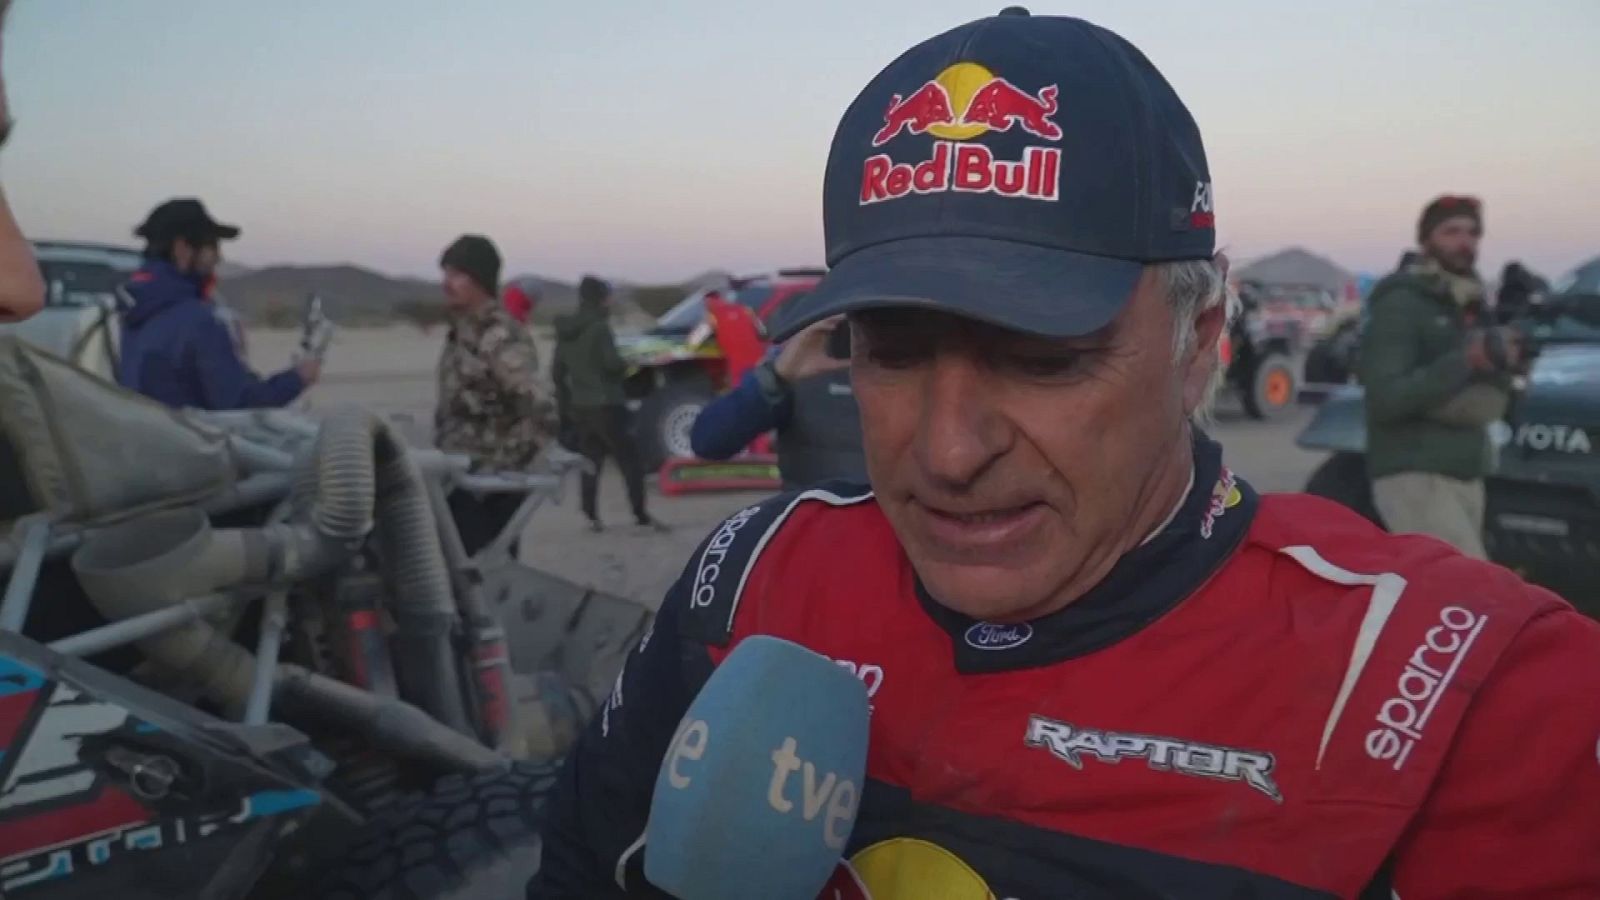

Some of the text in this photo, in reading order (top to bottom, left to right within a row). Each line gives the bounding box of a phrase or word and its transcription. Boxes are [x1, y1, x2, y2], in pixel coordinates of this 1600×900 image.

[860, 141, 1061, 205] Red Bull
[1365, 606, 1487, 770] sparco
[768, 736, 858, 850] tve
[1025, 714, 1283, 804] RAPTOR
